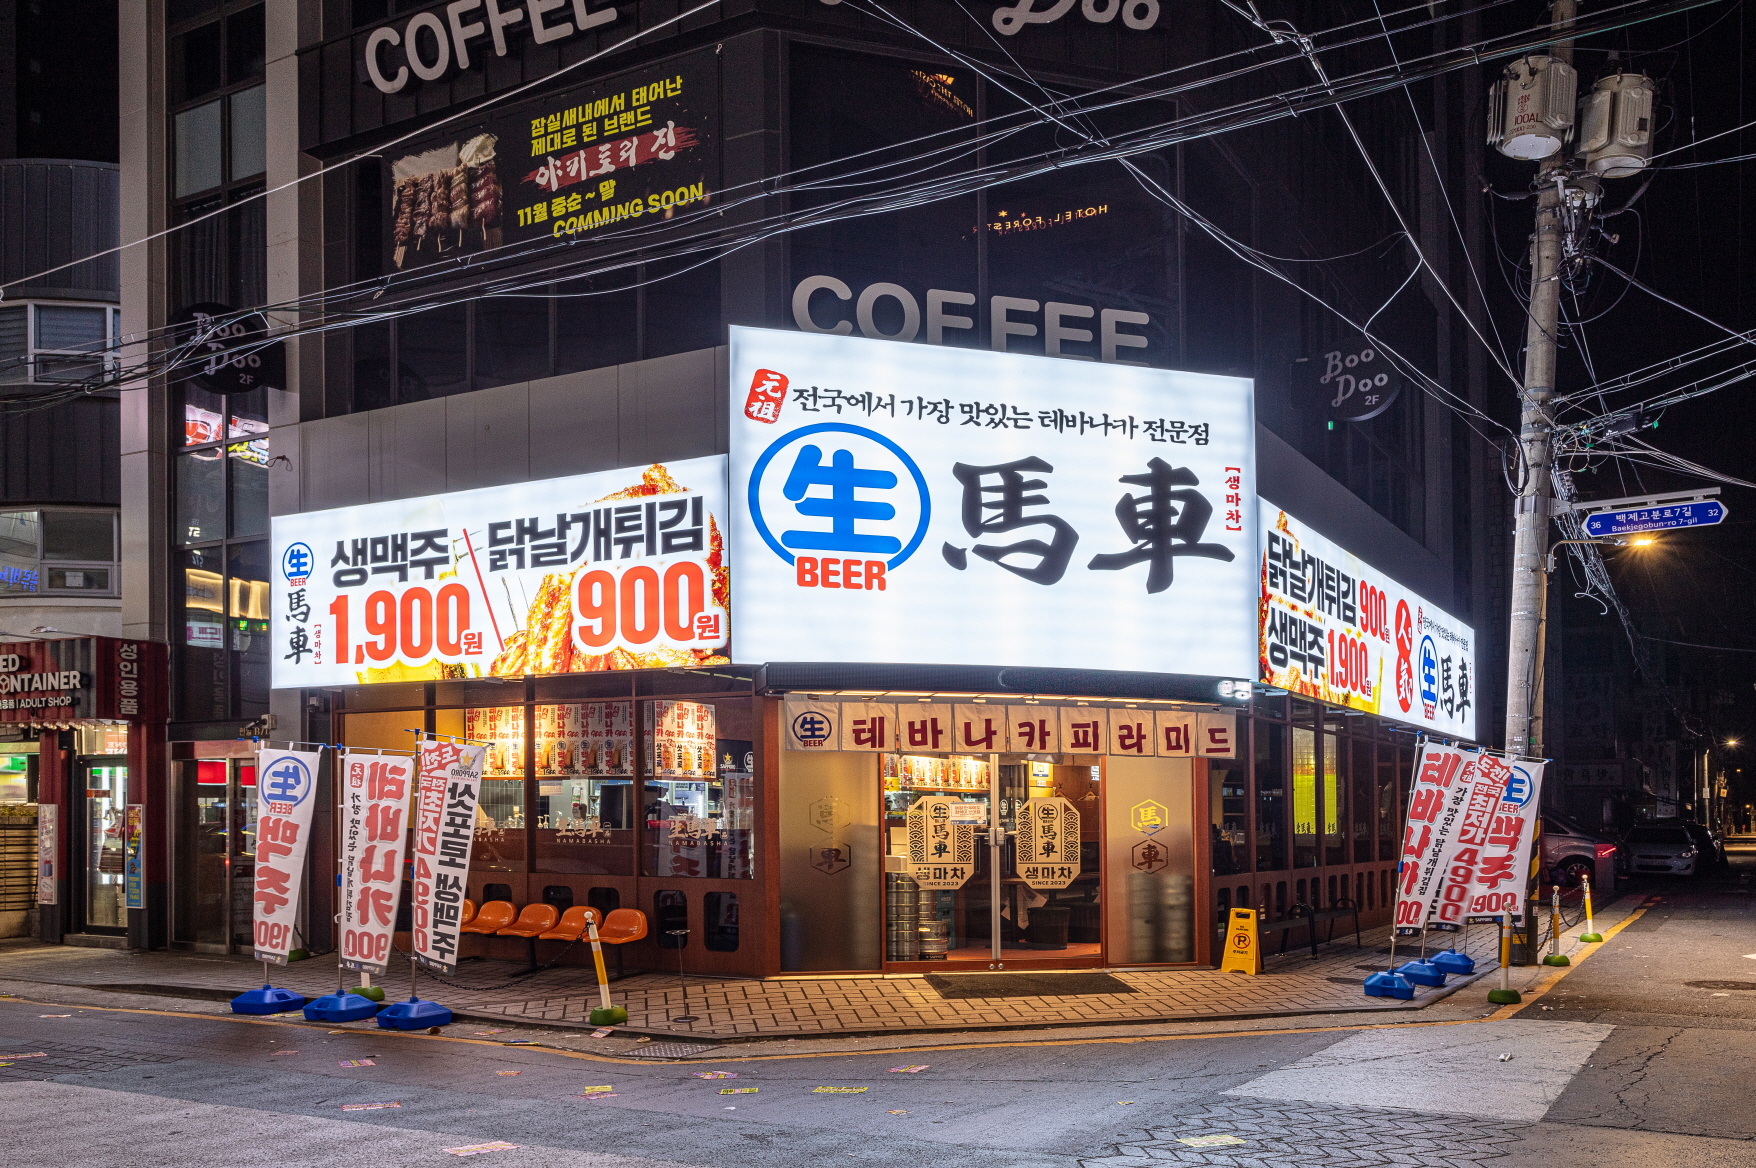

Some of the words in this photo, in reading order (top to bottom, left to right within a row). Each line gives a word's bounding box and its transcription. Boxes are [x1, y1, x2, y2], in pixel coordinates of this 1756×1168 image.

[531, 92, 625, 138] 잠실새내에서
[632, 75, 683, 106] 태어난
[531, 128, 578, 157] 제대로
[590, 126, 598, 142] 된
[604, 106, 652, 136] 브랜드
[535, 137, 640, 192] 야키토리
[651, 120, 676, 161] 진
[517, 201, 549, 228] 11월
[552, 192, 582, 218] 중순
[599, 180, 617, 202] 말
[553, 198, 644, 238] COMMING
[648, 182, 704, 213] SOON
[792, 275, 1150, 367] COFFEE
[240, 373, 254, 385] 2F
[1320, 348, 1375, 385] Boo
[1331, 373, 1389, 408] Doo
[1364, 394, 1380, 405] 2F
[793, 385, 896, 418] 전국에서
[900, 396, 955, 425] 가장
[959, 401, 1034, 430] 맛있는
[1038, 408, 1139, 440] 테바나카
[1142, 418, 1210, 446] 전문점
[780, 443, 902, 555] 生
[1616, 506, 1692, 523] 백제고분로7길
[1707, 509, 1719, 517] 32
[488, 496, 704, 573] 닭날개튀김
[1590, 521, 1601, 530] 36
[1612, 519, 1677, 532] Baekjegobun-ro
[1679, 517, 1698, 526] 7-gil
[287, 548, 309, 578] 生
[330, 527, 449, 588] 생맥주
[796, 555, 888, 592] BEER
[290, 577, 307, 587] BEER
[1268, 530, 1357, 628] 닭날개튀김
[1268, 606, 1326, 681] 생맥주
[119, 643, 138, 715] 성인용품
[1422, 646, 1436, 703] 生
[20, 698, 46, 709] ADULT
[48, 696, 72, 707] SHOP
[800, 715, 826, 741] 生
[802, 740, 824, 748] BEER
[1452, 786, 1467, 807] 가장
[1474, 784, 1501, 798] 전국
[1439, 807, 1459, 836] 맛있는
[1459, 794, 1495, 845] 최저가
[915, 866, 966, 881] 생마차
[1024, 866, 1073, 880] 생마차
